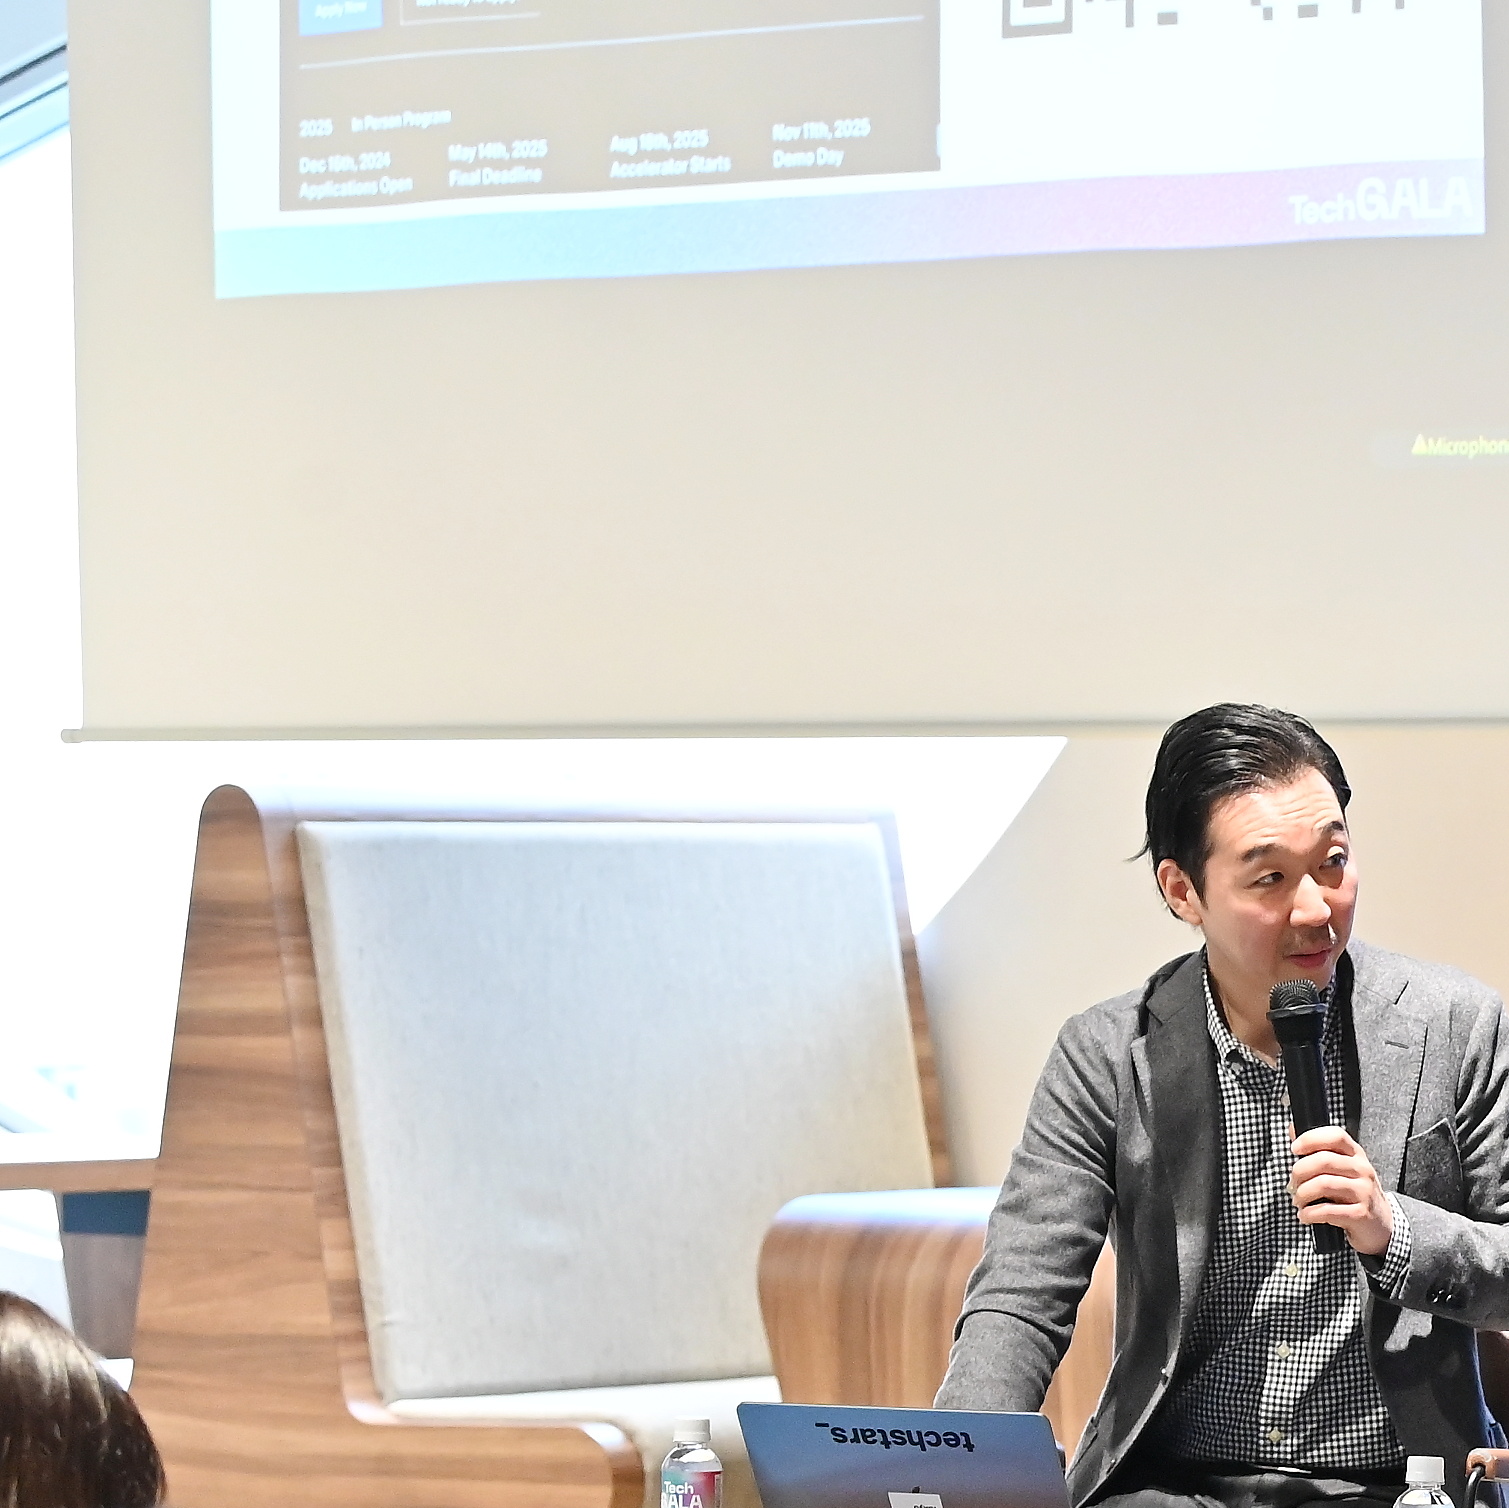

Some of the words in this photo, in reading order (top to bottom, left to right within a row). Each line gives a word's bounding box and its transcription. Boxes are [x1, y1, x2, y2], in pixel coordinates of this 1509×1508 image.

[609, 135, 638, 156] Aug
[672, 128, 710, 150] 2025
[773, 123, 802, 142] Nov
[833, 118, 871, 138] 2025
[448, 144, 477, 164] May
[511, 138, 548, 158] 2025
[773, 149, 815, 168] Demo
[816, 146, 845, 168] Day
[448, 168, 481, 188] Final
[482, 165, 543, 185] Deadline
[609, 160, 689, 178] Accelerator
[689, 154, 732, 175] Starts
[299, 180, 378, 201] Applications
[379, 175, 413, 195] Open
[1288, 193, 1356, 225] Tech
[1356, 176, 1474, 221] GALA
[663, 1480, 694, 1496] Tech
